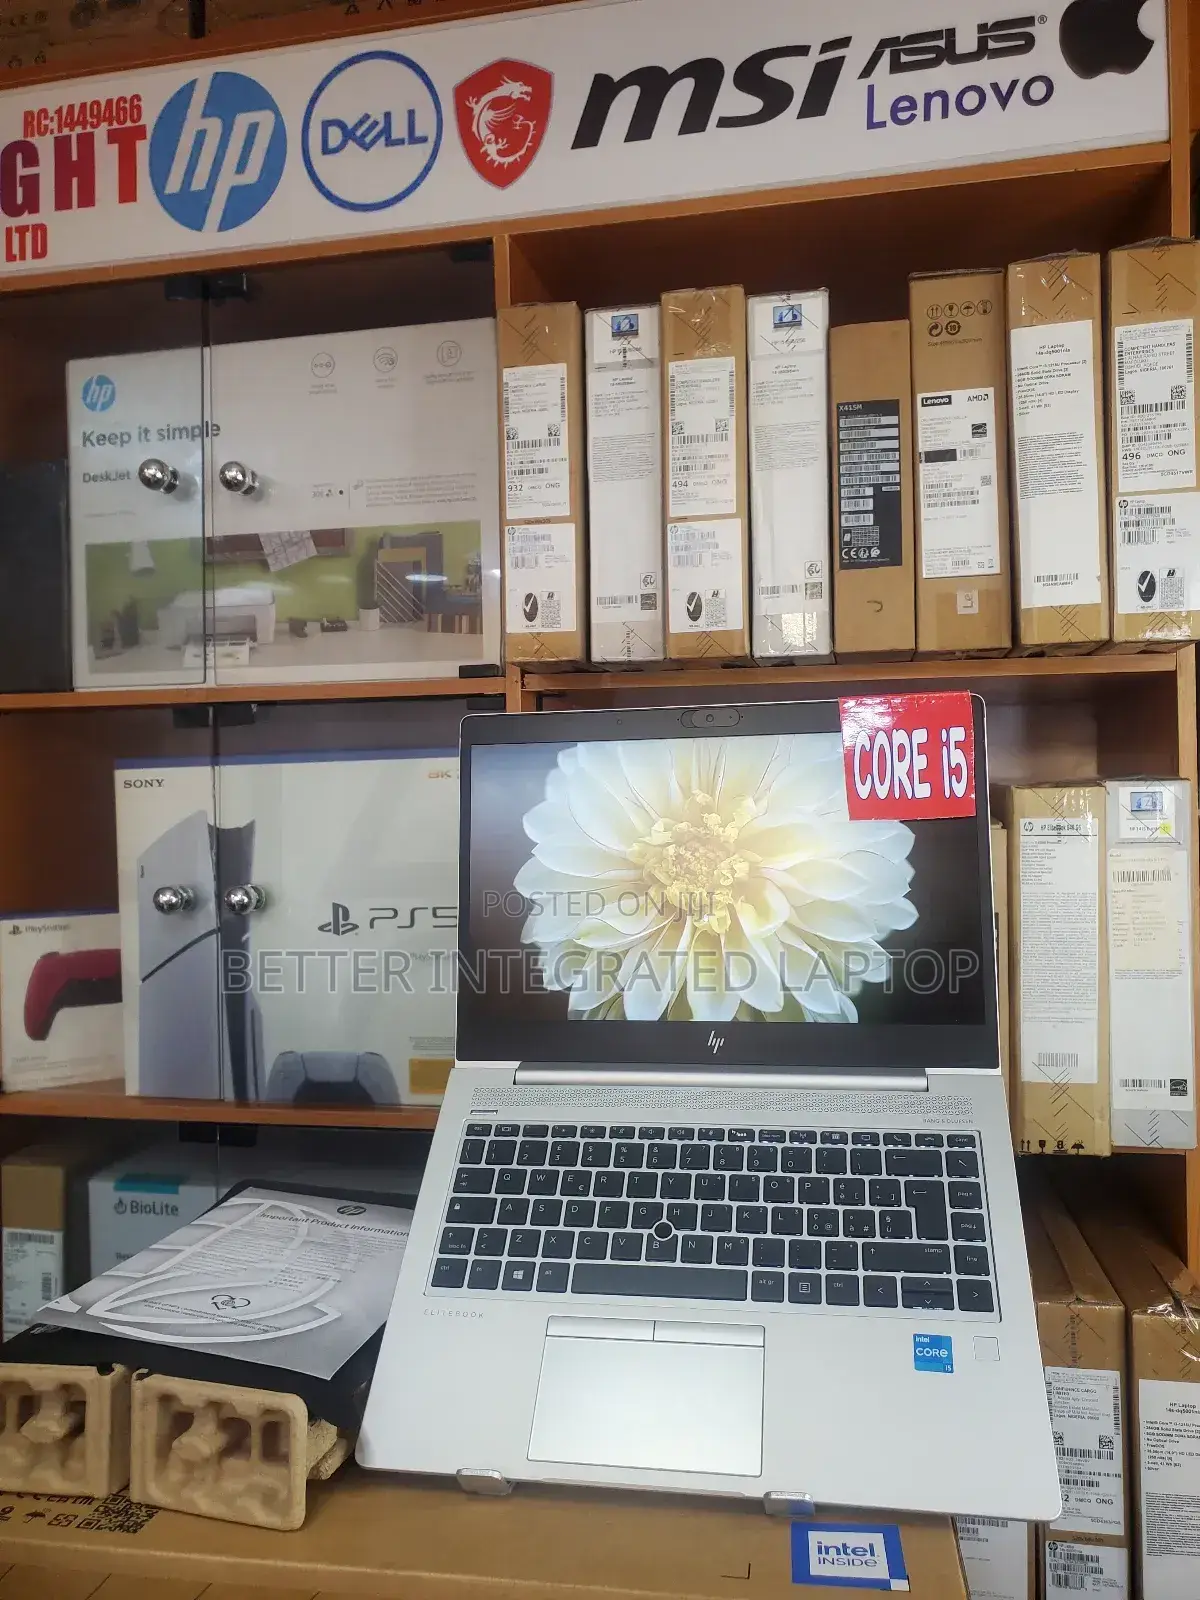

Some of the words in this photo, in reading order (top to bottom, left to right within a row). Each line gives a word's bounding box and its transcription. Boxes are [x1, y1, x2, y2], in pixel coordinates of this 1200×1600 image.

[571, 35, 853, 150] msi
[865, 74, 1055, 131] Lenovo
[23, 94, 142, 137] RC:1449466
[321, 108, 428, 157] DELL
[160, 72, 280, 232] hp
[0, 124, 147, 218] GHT
[5, 223, 48, 263] LTD
[82, 430, 132, 447] Keep
[138, 425, 151, 442] it
[157, 420, 221, 442] simple
[1122, 452, 1141, 460] 496
[82, 470, 131, 483] DeskJet
[507, 484, 524, 492] 932
[672, 480, 688, 488] 494
[852, 727, 931, 800] CORE
[941, 726, 969, 798] i5
[123, 779, 165, 789] SONY
[130, 1200, 179, 1216] BioLite
[259, 1213, 309, 1224] Important
[310, 1218, 351, 1229] Product
[350, 1224, 409, 1237] Information
[424, 1308, 484, 1319] ELITEBOOK
[817, 1541, 875, 1557] intel
